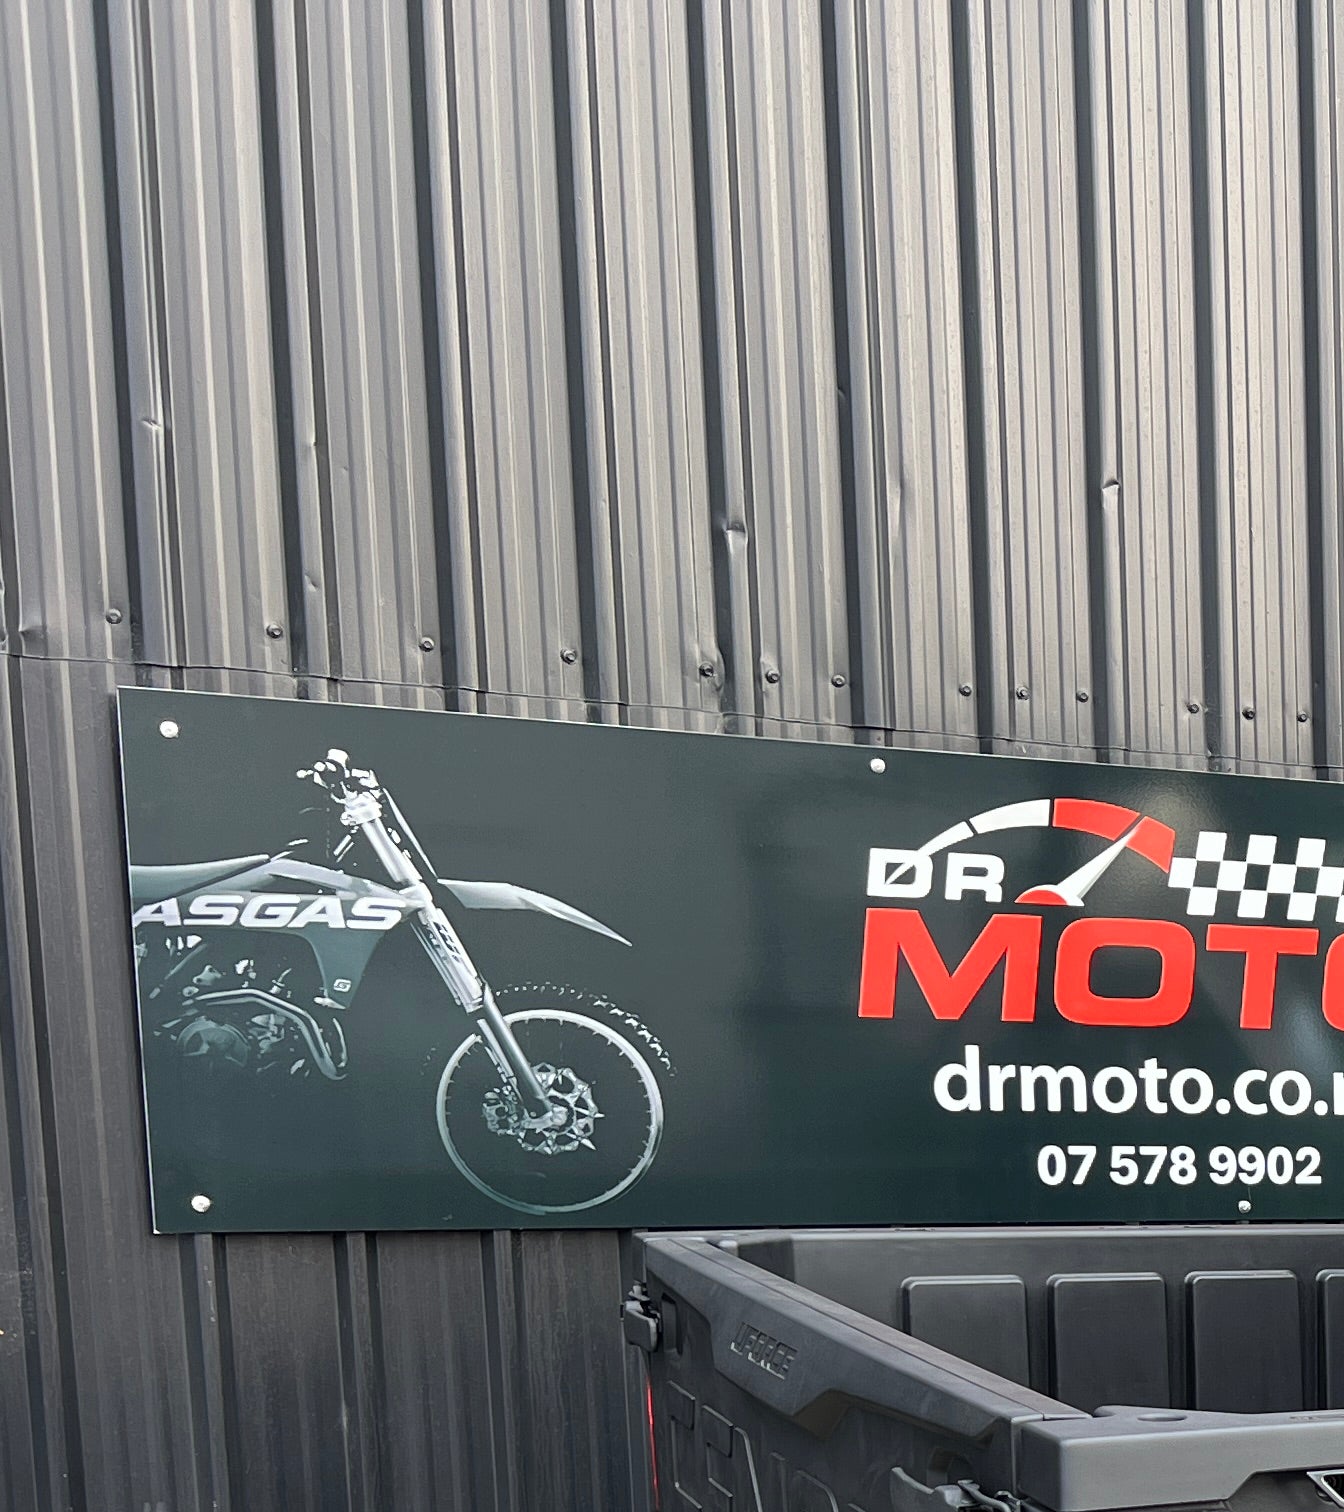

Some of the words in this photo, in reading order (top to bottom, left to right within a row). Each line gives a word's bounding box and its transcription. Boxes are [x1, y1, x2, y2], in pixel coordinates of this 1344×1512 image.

[866, 847, 1005, 903] DR
[133, 894, 406, 930] ASGAS
[1037, 1145, 1096, 1185] 07
[1108, 1145, 1197, 1185] 578
[1209, 1146, 1322, 1186] 9902
[730, 1321, 799, 1380] UFORCE
